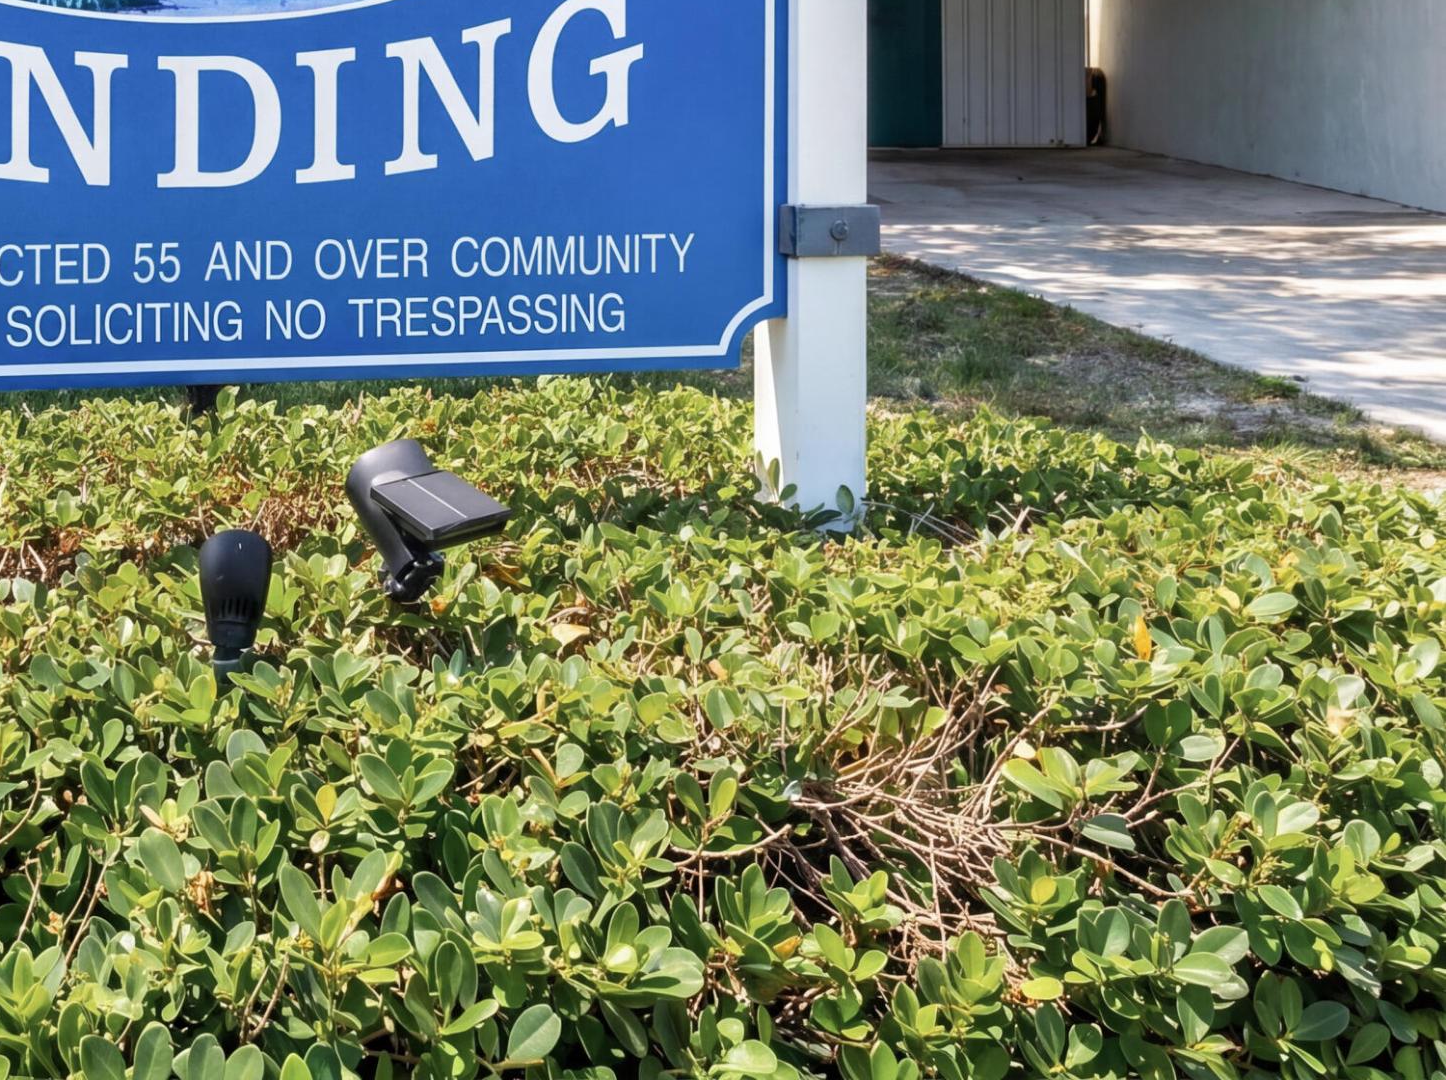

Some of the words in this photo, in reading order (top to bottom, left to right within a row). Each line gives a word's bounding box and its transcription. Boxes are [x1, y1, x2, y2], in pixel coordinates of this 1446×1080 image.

[133, 242, 182, 284] 55
[204, 240, 294, 281] AND
[314, 237, 429, 281] OVER
[451, 232, 695, 278] COMMUNITY
[6, 300, 244, 348] SOLICITING
[265, 298, 326, 341] NO
[347, 292, 626, 339] TRESPASSING
